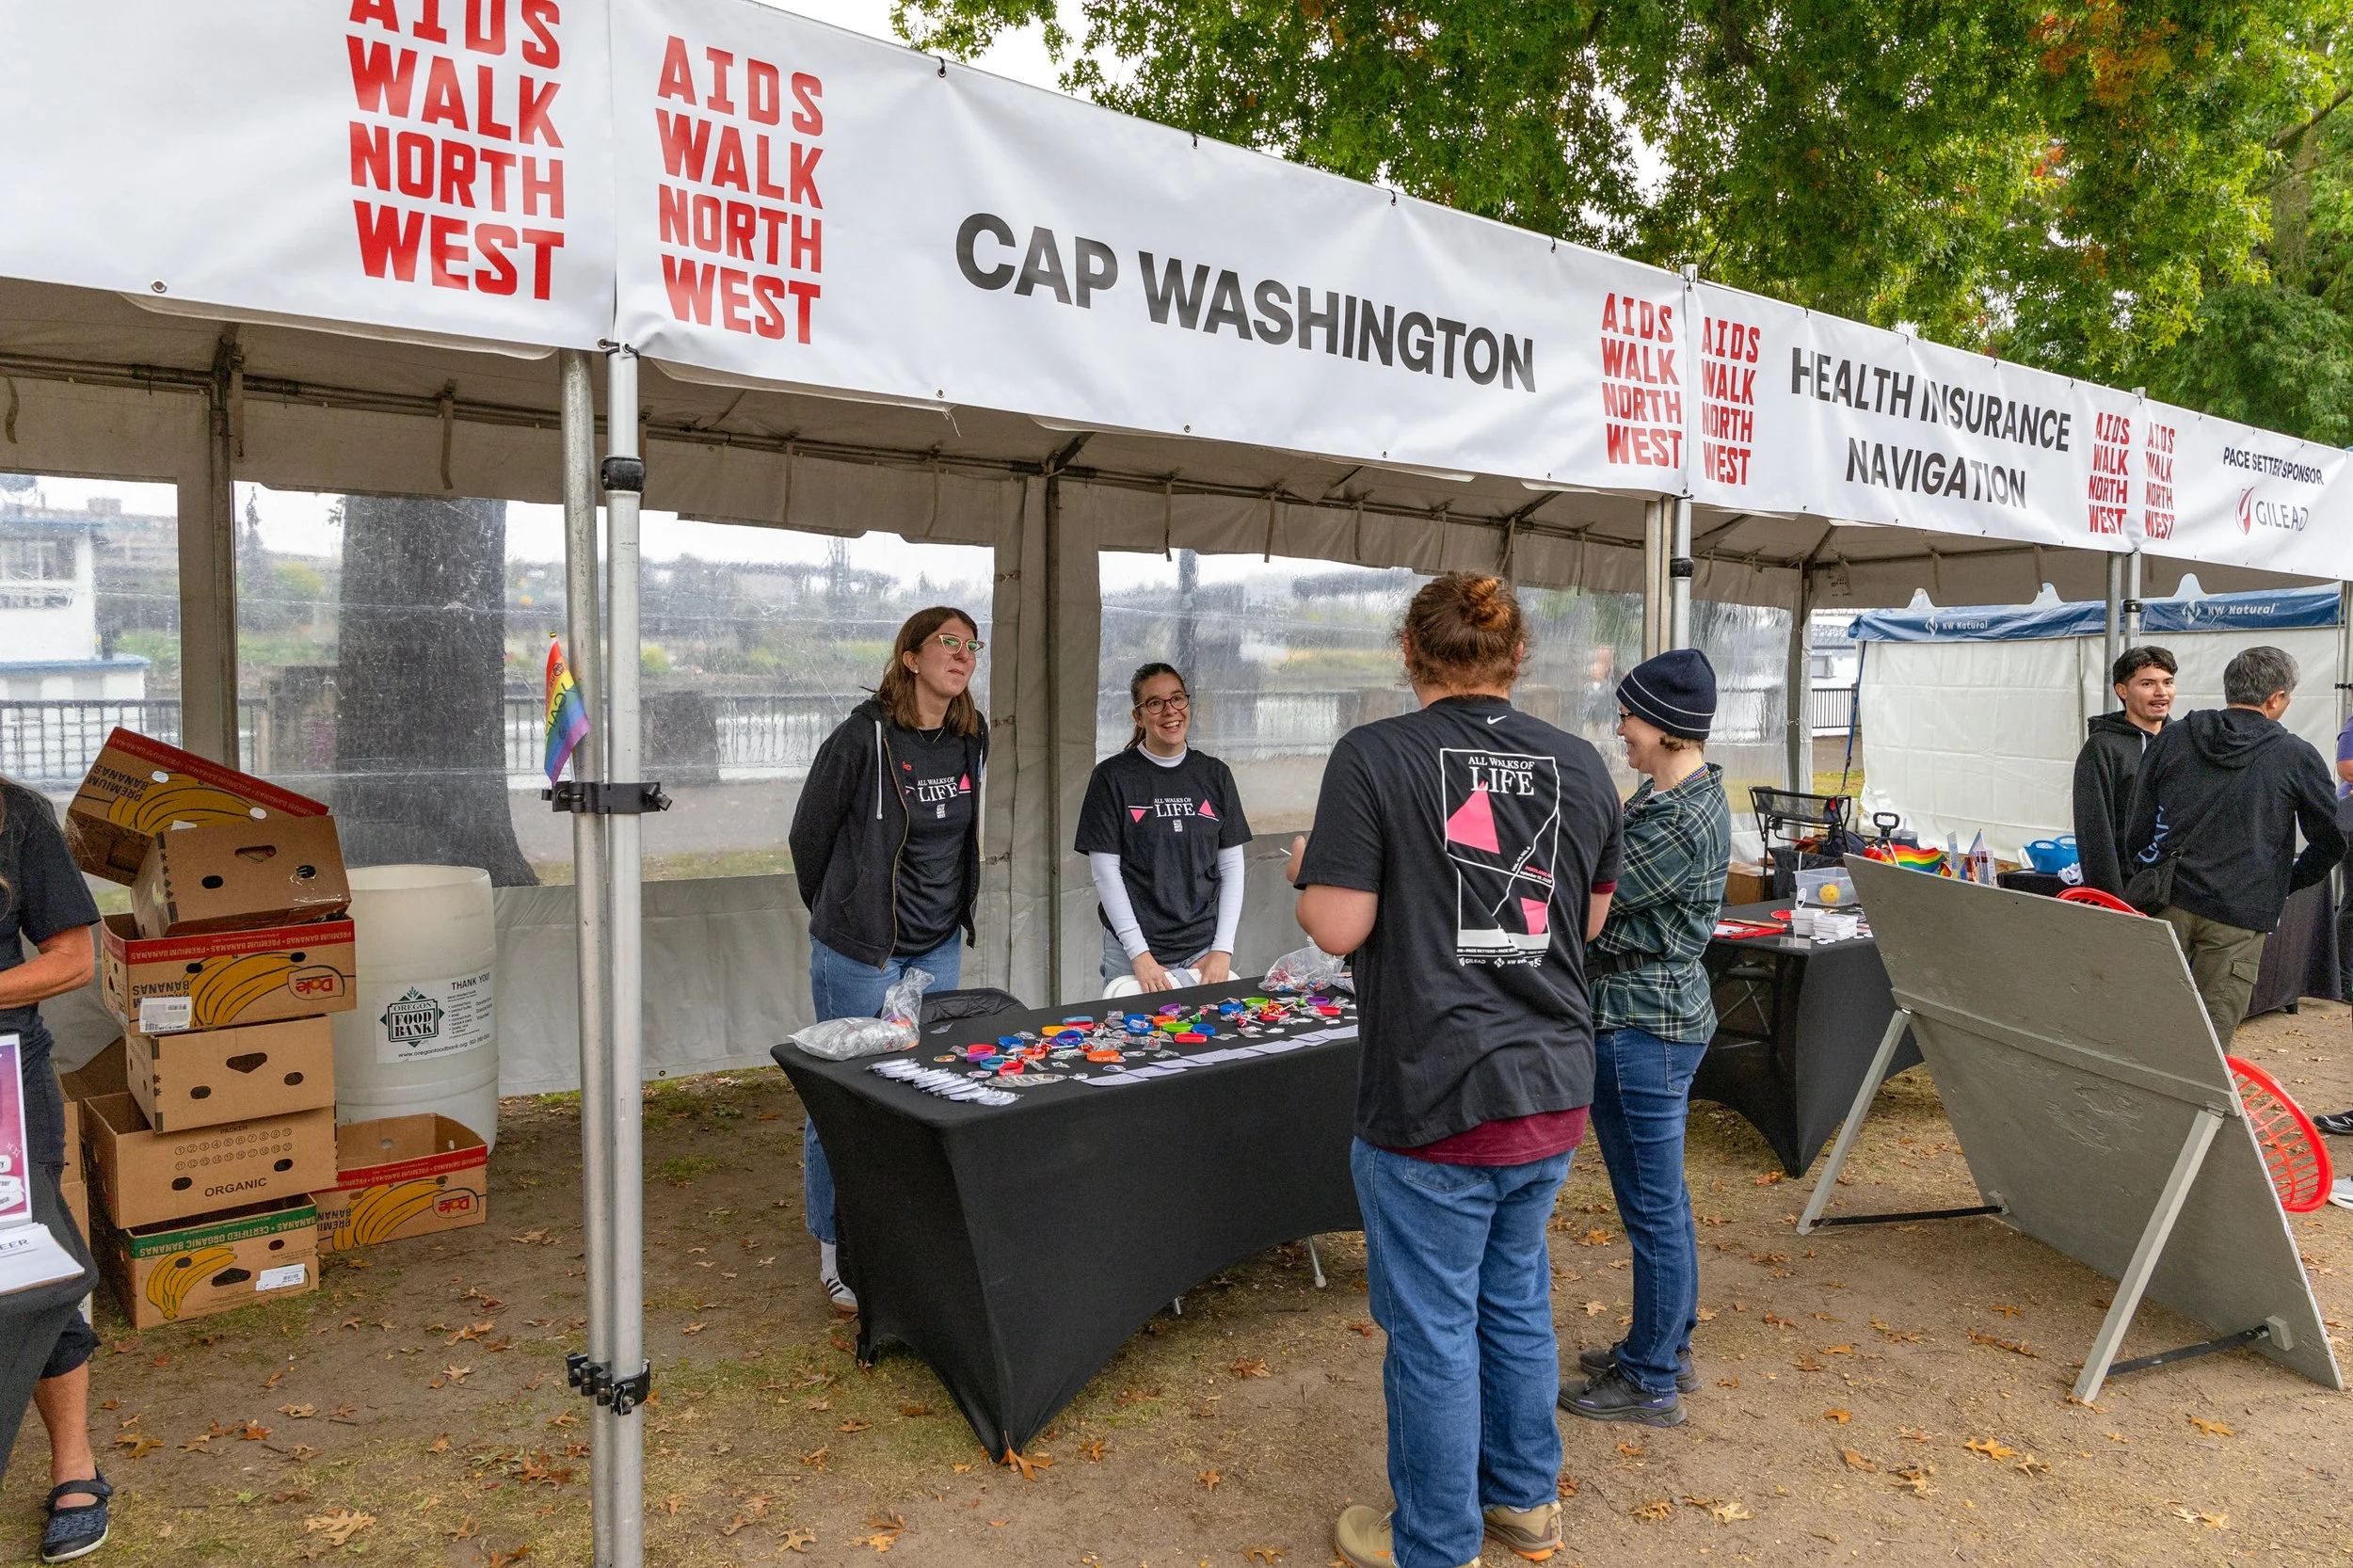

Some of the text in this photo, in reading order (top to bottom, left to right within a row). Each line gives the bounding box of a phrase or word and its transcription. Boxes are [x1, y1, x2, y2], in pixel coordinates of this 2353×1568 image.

[345, 34, 565, 149] WALK
[657, 35, 824, 136] AIDS
[349, 120, 565, 219] NORTH
[655, 107, 824, 210] WALK
[659, 184, 823, 274] NORTH
[353, 200, 565, 301] WEST
[661, 253, 823, 345] WEST
[955, 213, 1537, 393] CAP WASHINGTON
[1602, 293, 1673, 344] AIDS
[1701, 316, 1761, 364] AIDS
[1601, 337, 1680, 386] WALK
[1701, 359, 1757, 406] WALK
[1602, 382, 1683, 424] NORTH
[1791, 346, 2073, 453] HEALTH INSURANCE
[1702, 401, 1753, 443] NORTH
[2094, 412, 2130, 445] AIDS
[1606, 424, 1683, 470] WEST
[2147, 422, 2175, 455] AIDS
[1703, 440, 1752, 486] WEST
[1845, 437, 2027, 509] NAVIGATION
[2093, 443, 2129, 476] WALK
[2145, 452, 2173, 484] WALK
[2223, 446, 2325, 486] PACE SETTER SPONSOR
[2089, 474, 2128, 504] NORTH
[2145, 481, 2174, 510] NORTH
[2089, 504, 2127, 535] WEST
[2144, 509, 2175, 540] WEST
[2255, 500, 2309, 532] GILEAD
[2208, 602, 2276, 616] NW Natural
[1942, 620, 1988, 631] NW Natural
[93, 764, 149, 792] BANANAS
[1468, 756, 1535, 770] ALL WALKS OF
[87, 775, 143, 801] PREMIUM
[918, 782, 958, 802] LIFE
[1469, 766, 1535, 796] LIFE
[1154, 803, 1195, 818] LIFE
[132, 981, 189, 995] BANANAS
[296, 978, 333, 995] Dole
[452, 977, 477, 990] THANK
[393, 1001, 433, 1012] OREGON
[395, 1011, 432, 1026] FOOD
[395, 1022, 433, 1037] BANK
[204, 1177, 267, 1197] ORGANIC
[317, 1208, 352, 1221] BANAN
[439, 1197, 470, 1212] Dole
[226, 1225, 269, 1240] CERTIFIED
[316, 1218, 351, 1231] PREMI
[0, 1239, 29, 1251] EER
[138, 1240, 184, 1256] BANANAS
[184, 1233, 225, 1248] ORGANIC
